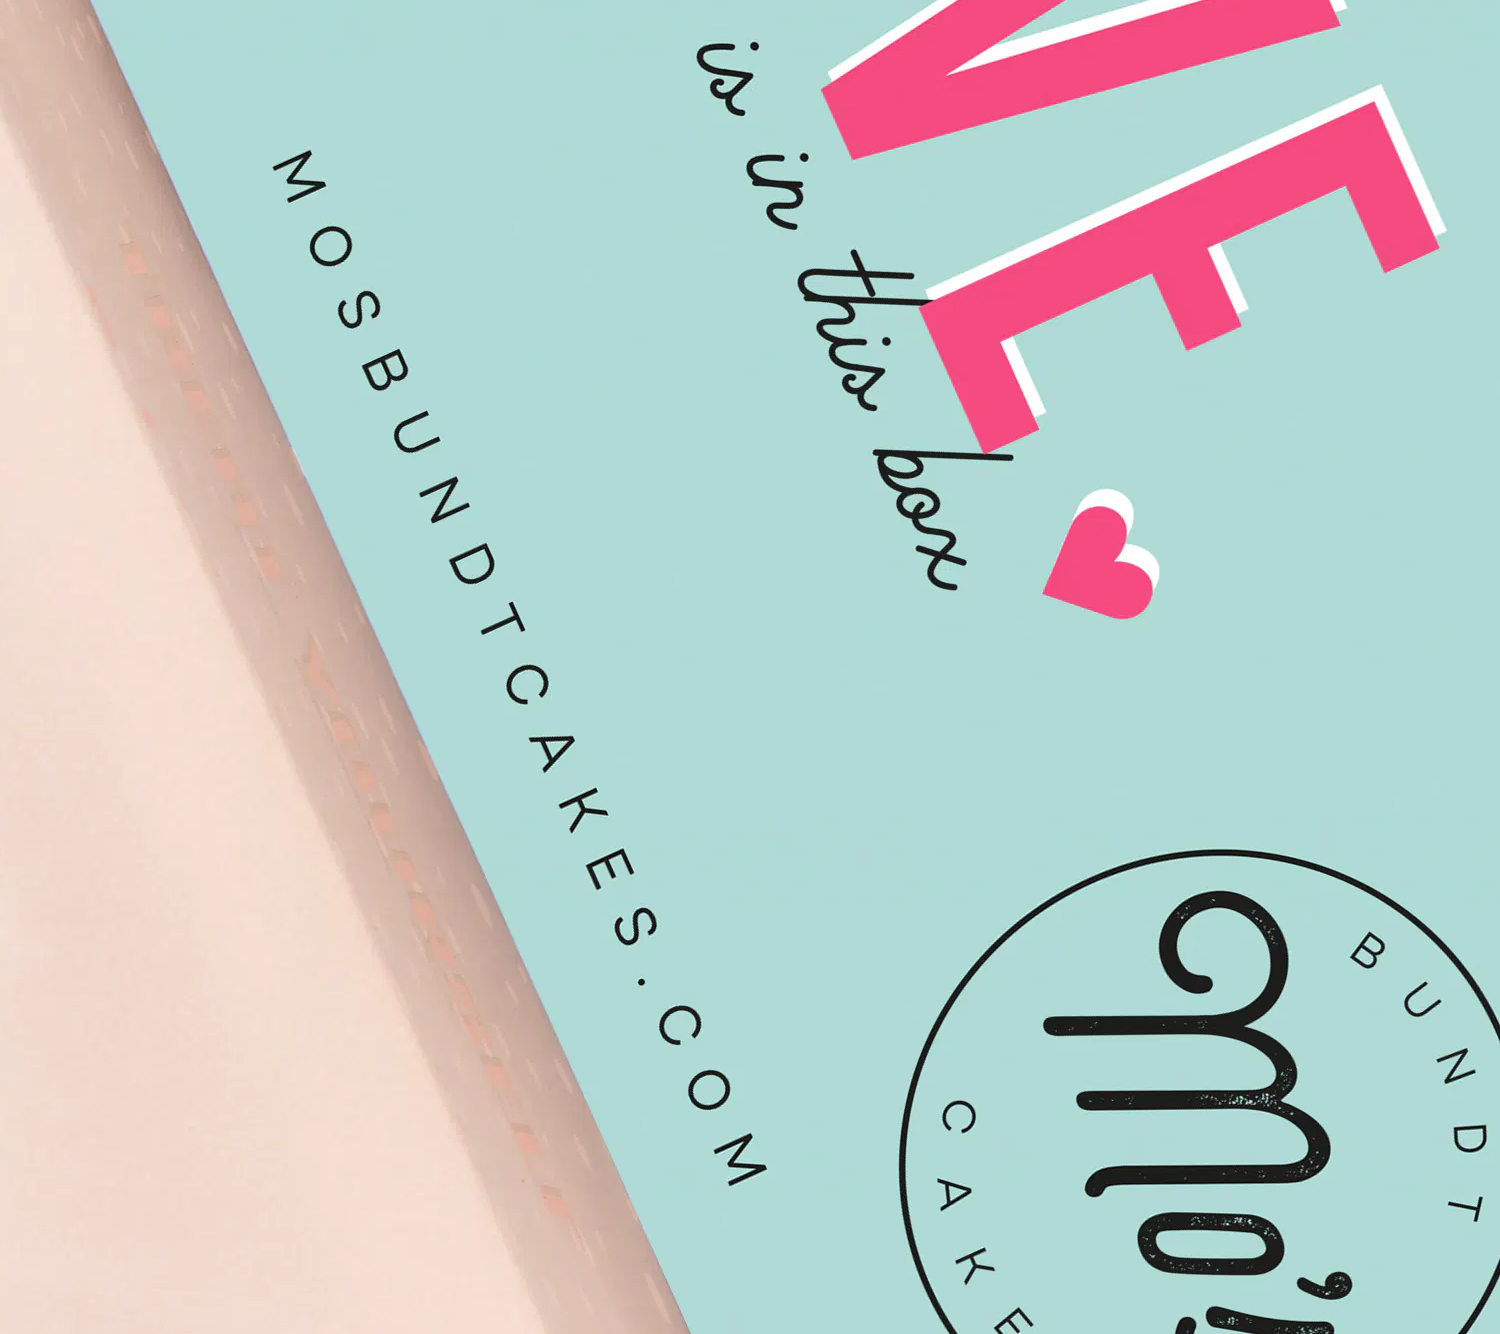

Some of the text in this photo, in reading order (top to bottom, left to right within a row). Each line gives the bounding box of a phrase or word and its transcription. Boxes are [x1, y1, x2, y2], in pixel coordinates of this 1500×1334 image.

[697, 42, 1013, 590] is in this box
[273, 150, 767, 1186] MOSBUNDTCAKES.COM
[1351, 932, 1487, 1222] BUNDT
